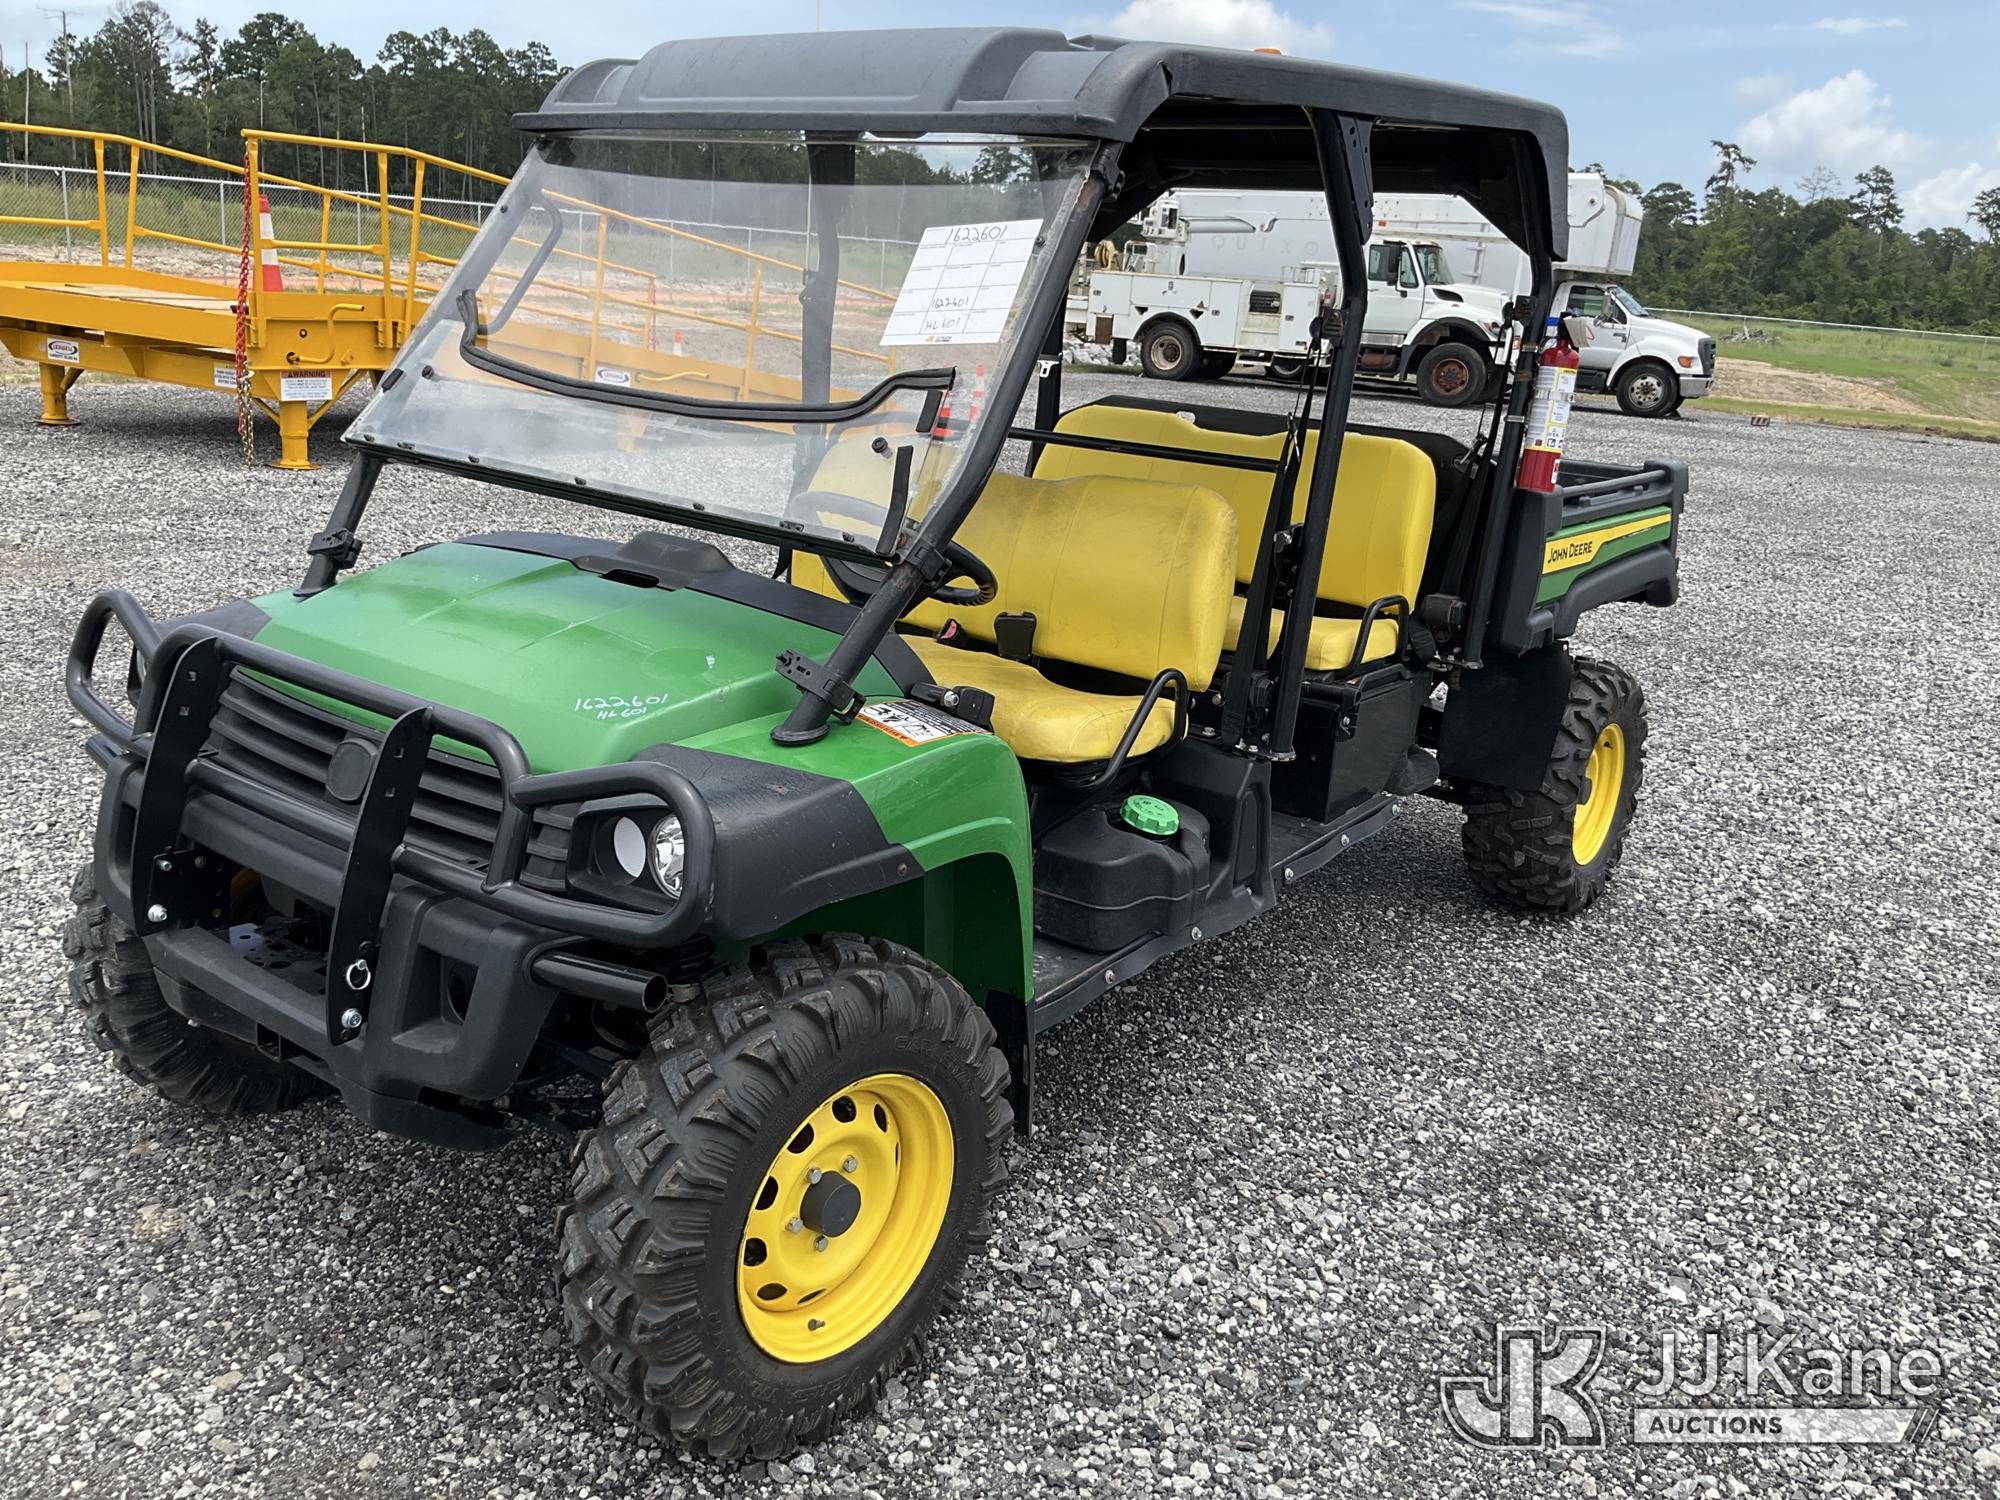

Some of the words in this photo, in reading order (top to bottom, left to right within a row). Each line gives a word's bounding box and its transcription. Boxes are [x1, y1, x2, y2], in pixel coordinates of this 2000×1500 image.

[945, 225, 1008, 244] 1622601
[931, 297, 969, 310] 1622601
[941, 317, 961, 329] 601
[293, 370, 326, 378] WARNING
[1547, 547, 1568, 564] JOHN
[1568, 541, 1593, 558] DEERE
[574, 693, 669, 711] 1622601
[620, 707, 648, 718] 601
